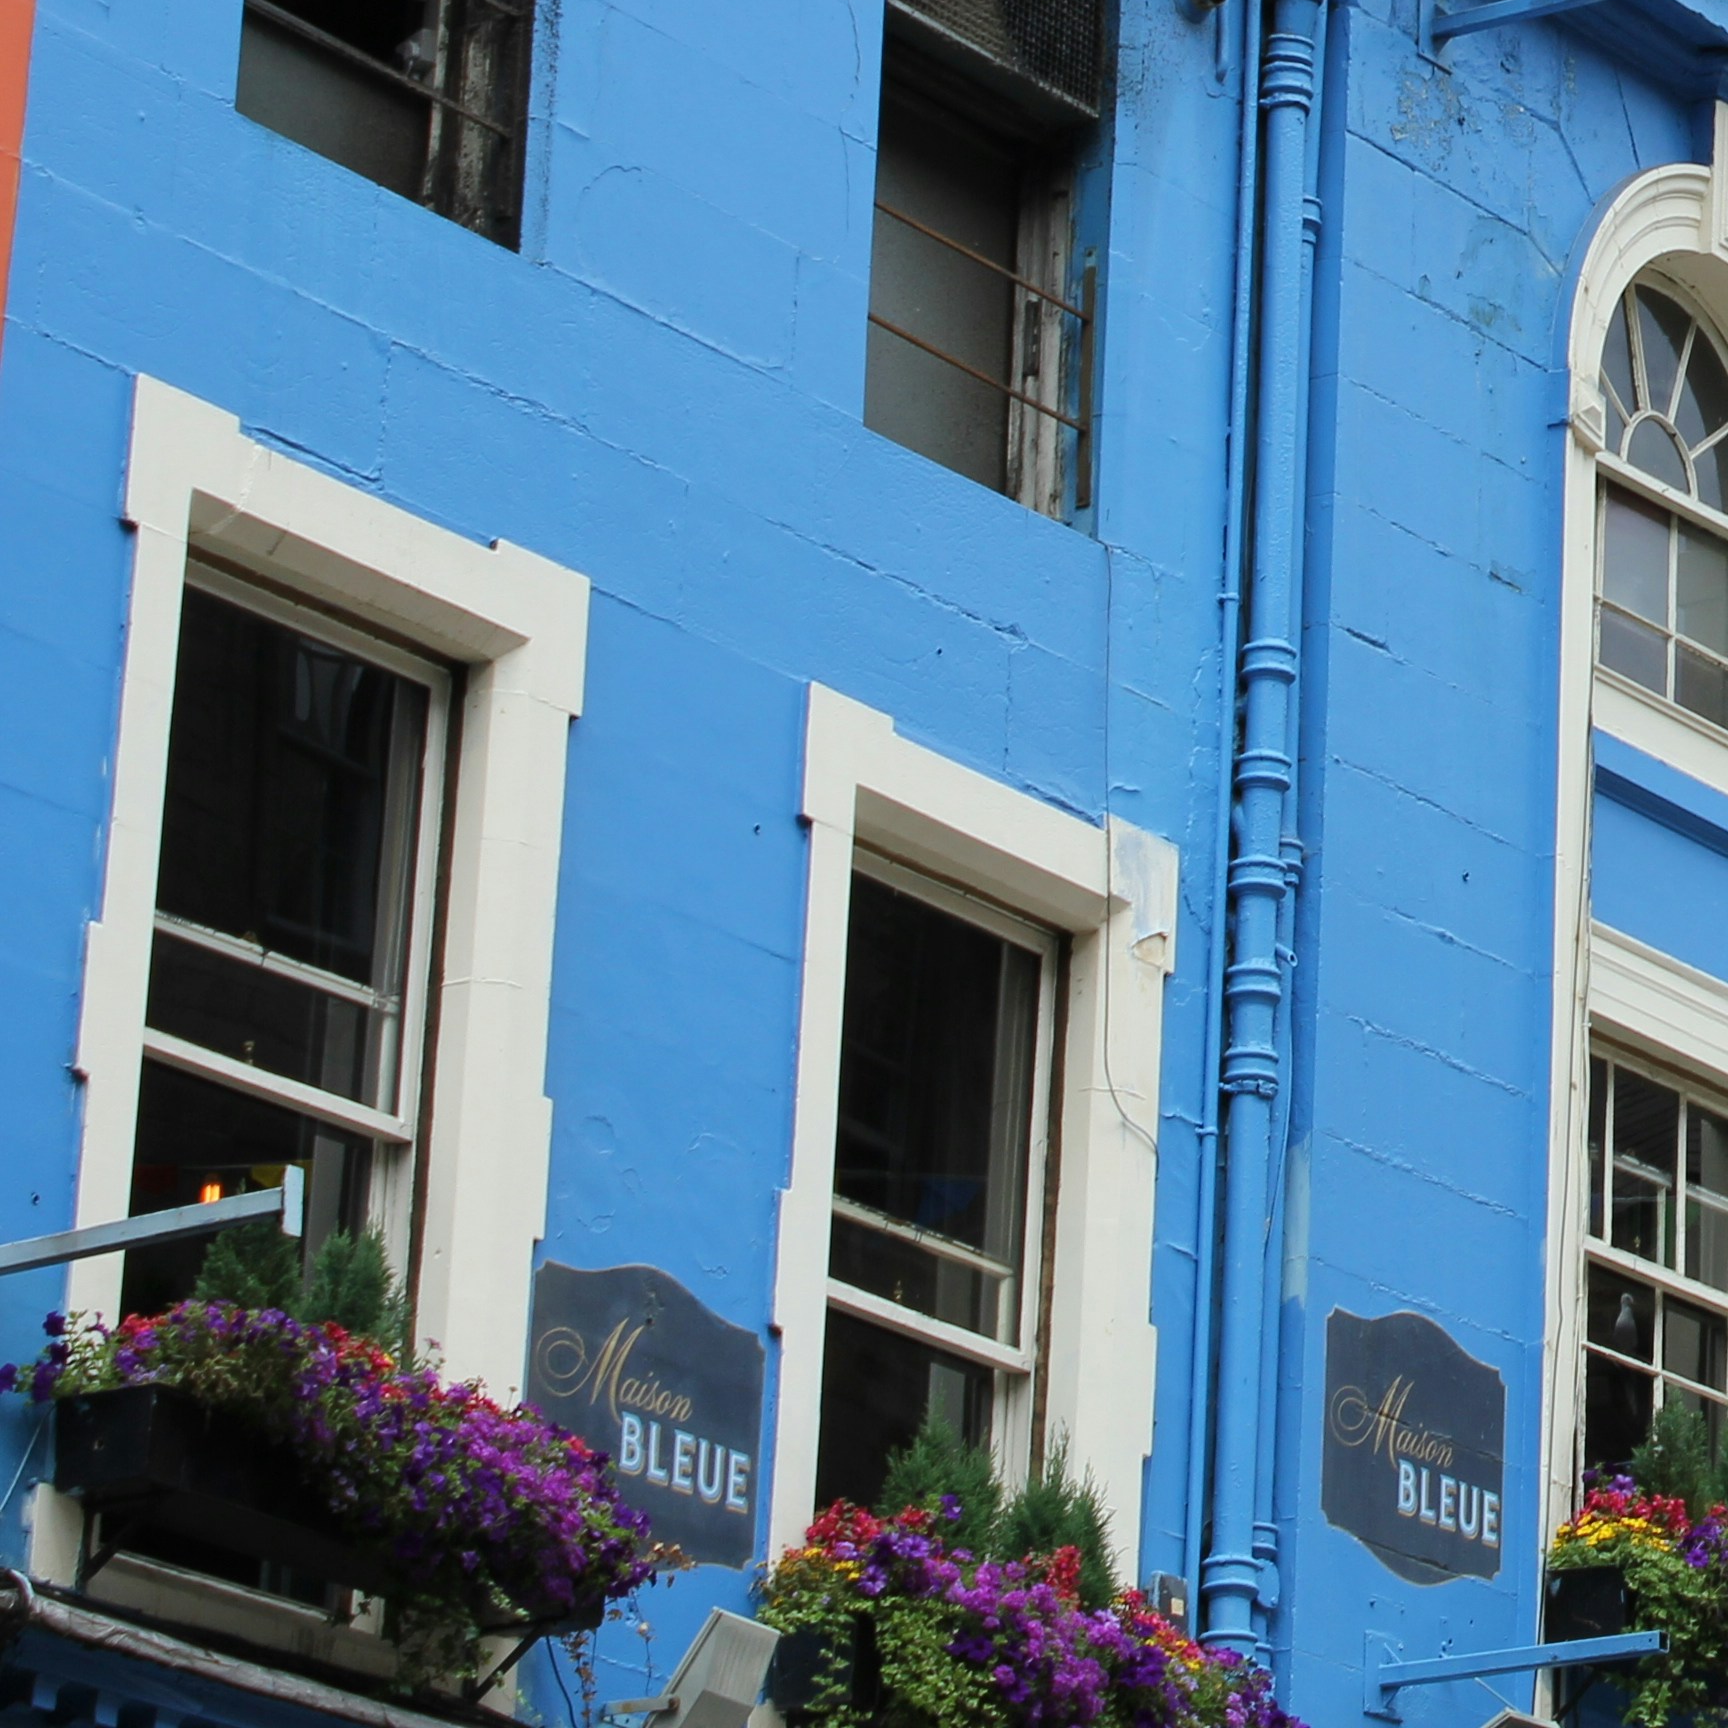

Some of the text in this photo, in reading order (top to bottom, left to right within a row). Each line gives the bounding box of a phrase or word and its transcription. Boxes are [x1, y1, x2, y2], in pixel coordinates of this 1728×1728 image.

[536, 1316, 694, 1423] Maison
[618, 1410, 751, 1514] BLEUE
[1330, 1374, 1454, 1469] Maison
[1396, 1457, 1500, 1549] BLEUE
